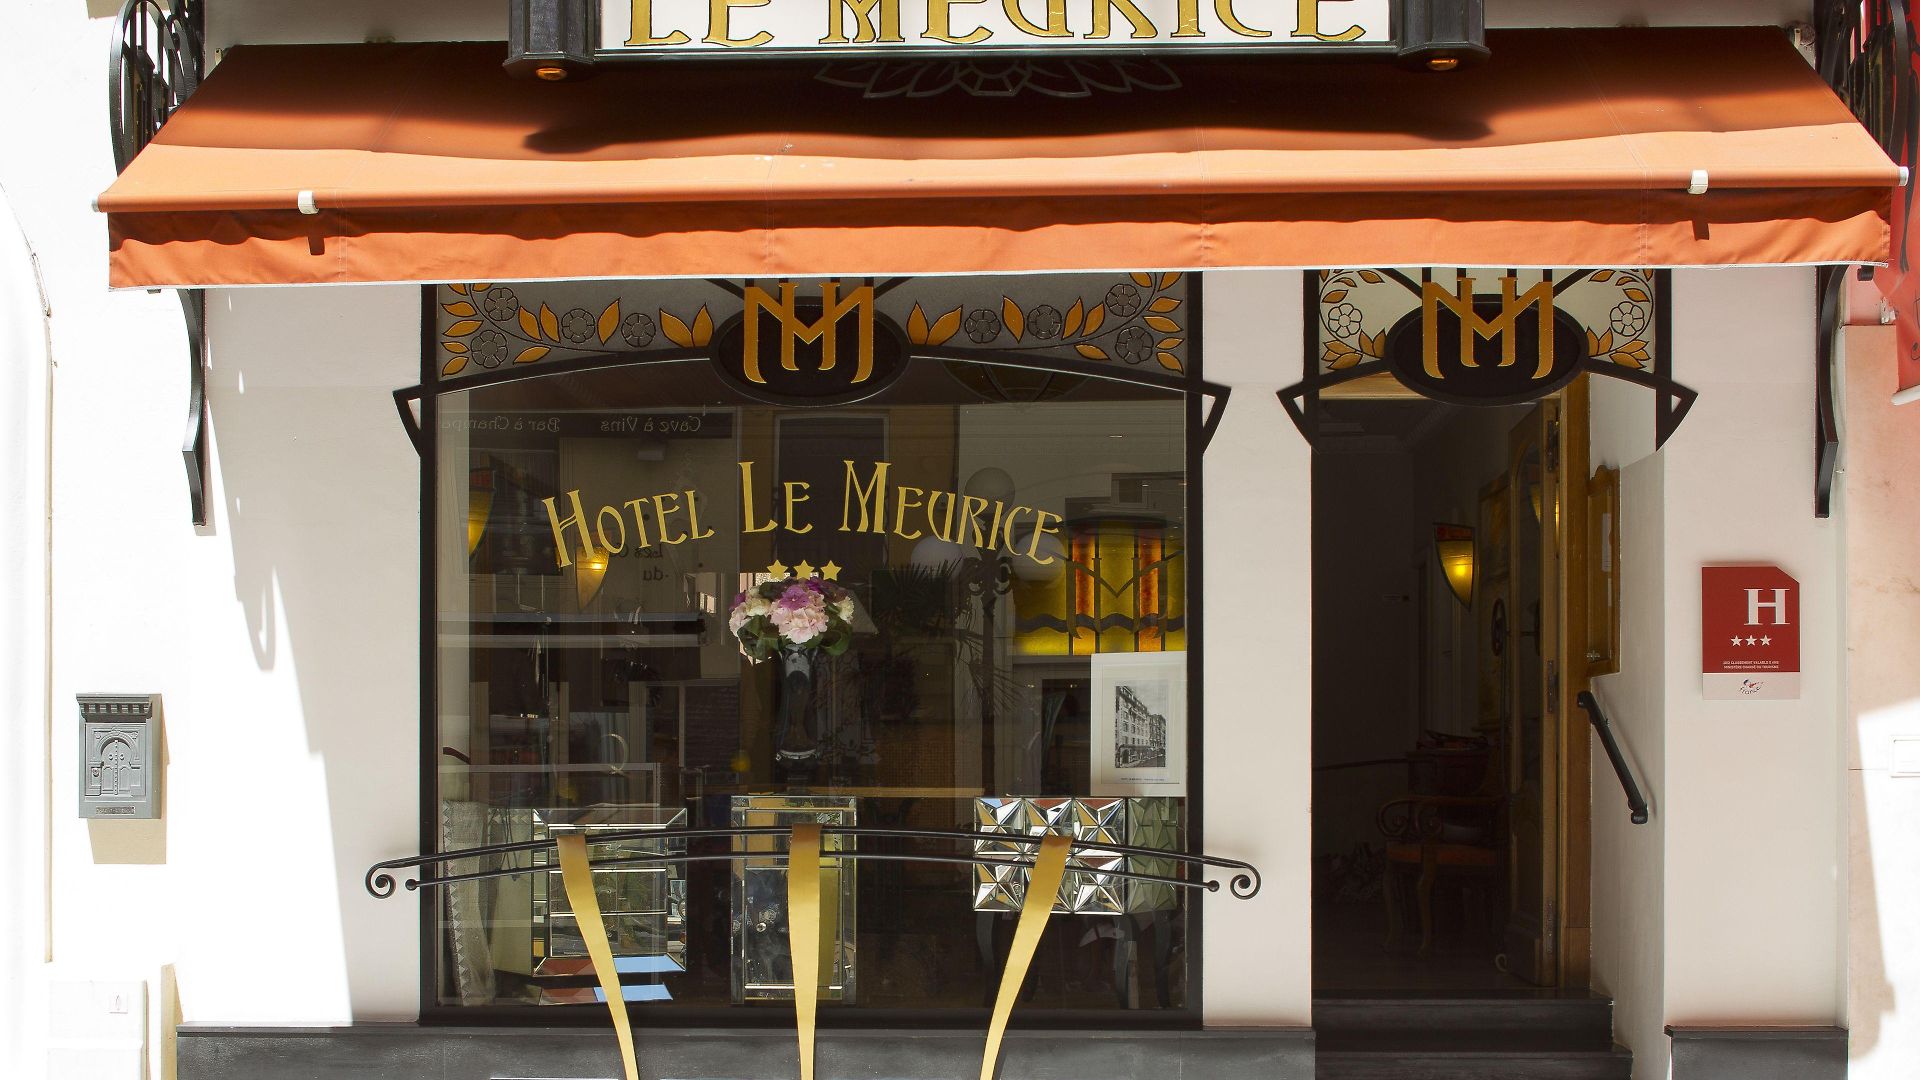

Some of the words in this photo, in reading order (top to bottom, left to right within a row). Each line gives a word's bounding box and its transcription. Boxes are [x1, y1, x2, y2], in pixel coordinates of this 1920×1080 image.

[542, 489, 715, 568] HOTEL
[738, 461, 814, 534] LE
[838, 459, 1063, 565] MEURICE
[1743, 588, 1791, 625] H
